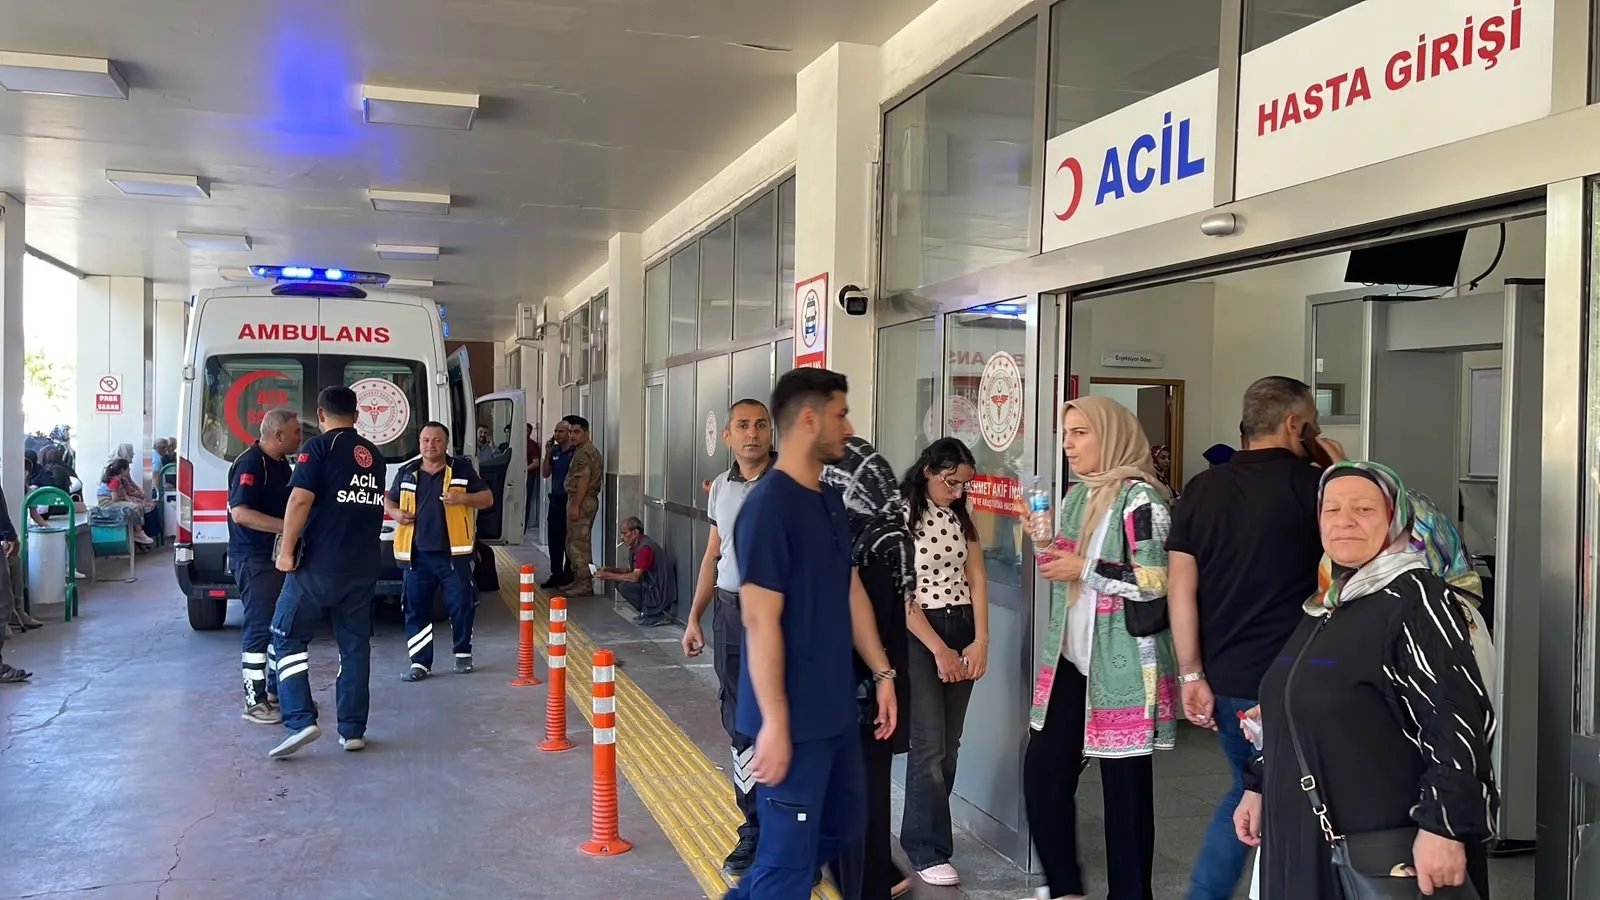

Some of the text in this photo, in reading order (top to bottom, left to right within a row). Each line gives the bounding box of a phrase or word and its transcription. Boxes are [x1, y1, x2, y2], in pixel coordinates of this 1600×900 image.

[1258, 0, 1522, 136] HASTA GİRİŞİ
[1095, 111, 1205, 206] ACİL
[238, 323, 390, 343] AMBULANS
[350, 473, 378, 489] ACİL
[992, 481, 1007, 498] AKİF
[336, 488, 384, 506] SAĞLIK
